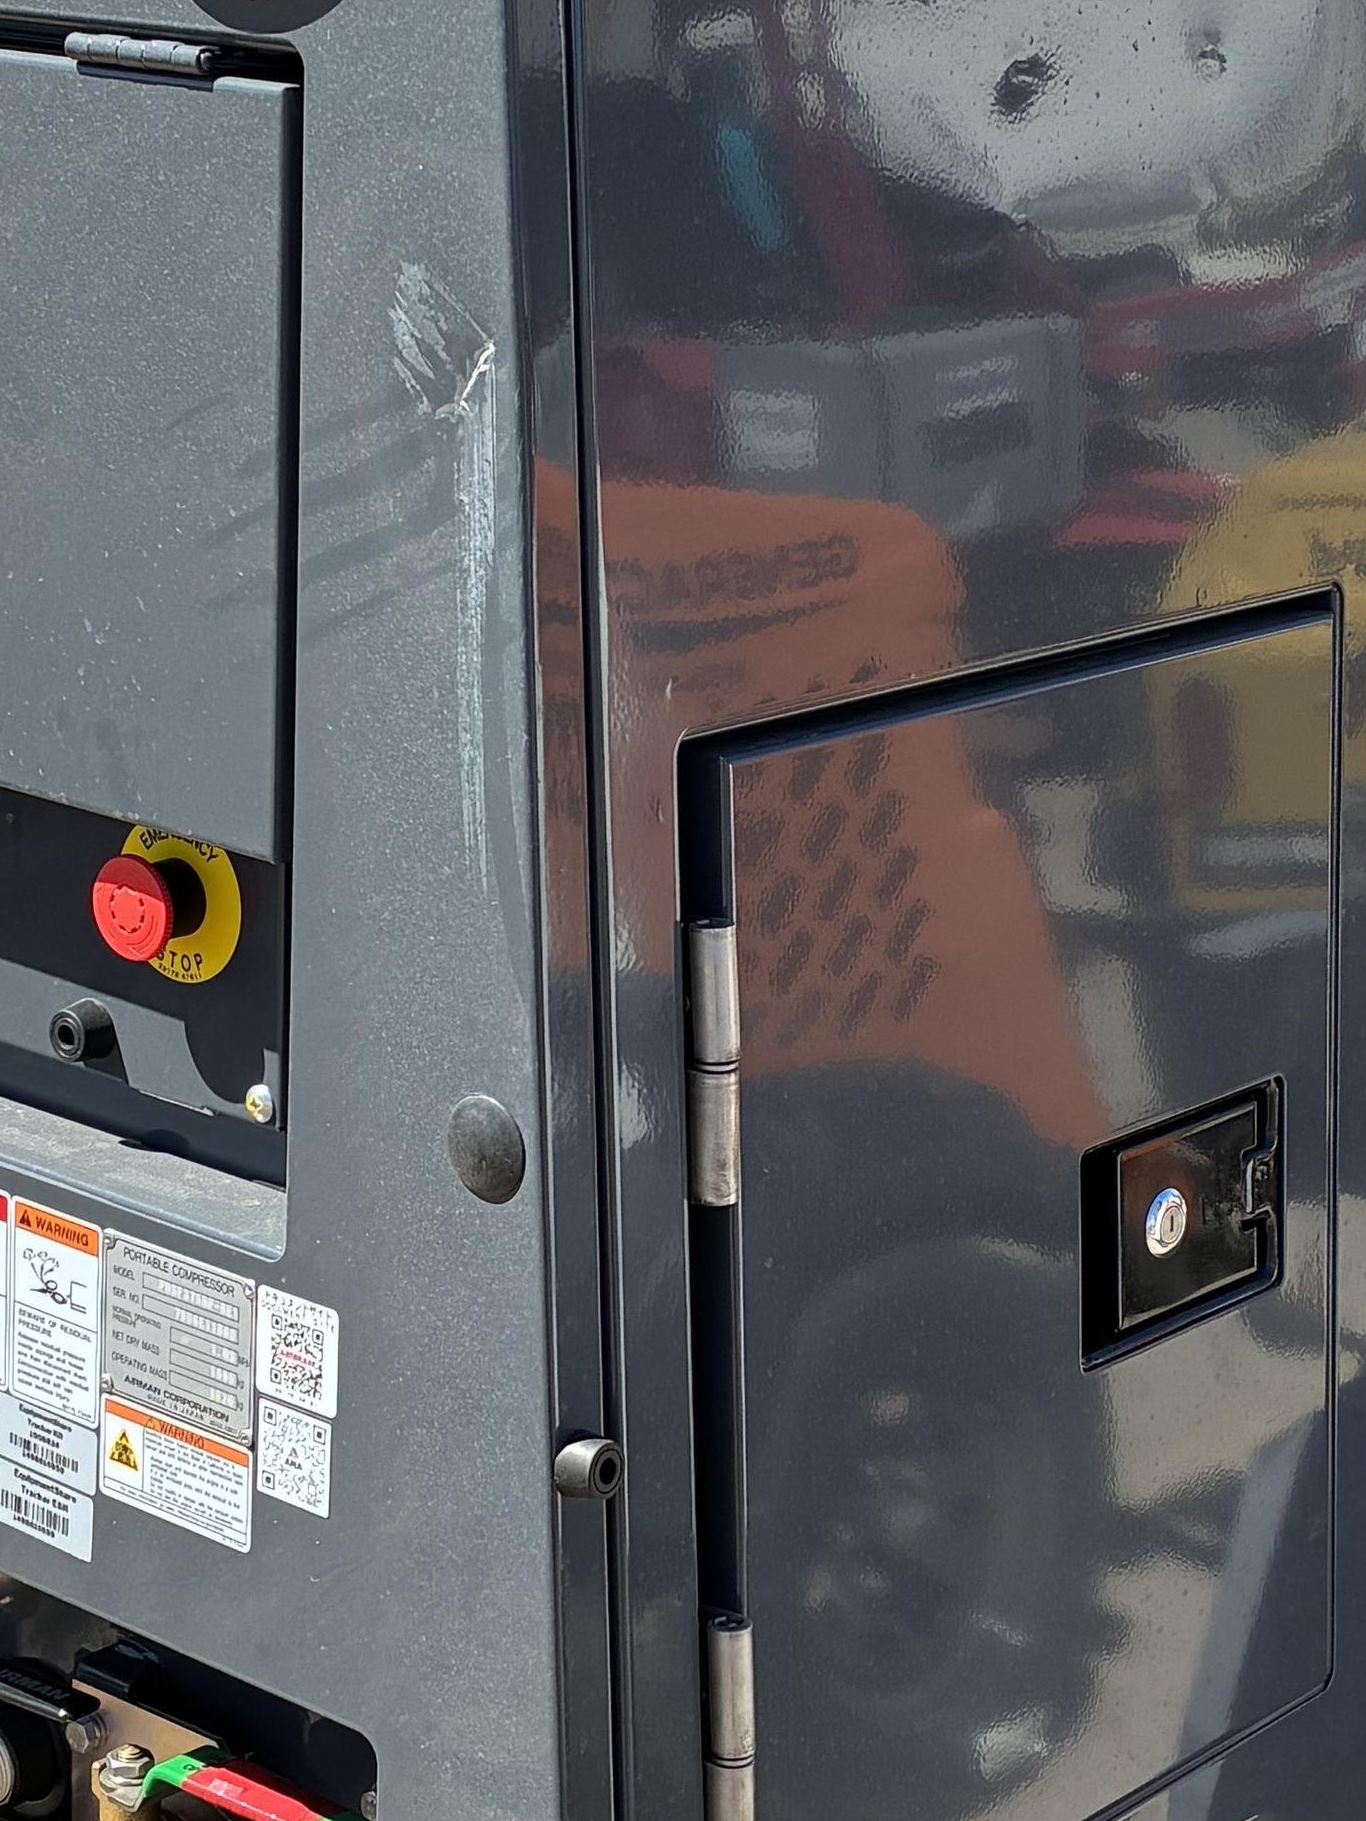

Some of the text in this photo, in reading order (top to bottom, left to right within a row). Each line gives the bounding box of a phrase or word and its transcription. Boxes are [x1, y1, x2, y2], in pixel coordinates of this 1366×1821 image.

[35, 1219, 90, 1248] WARNING
[123, 1246, 235, 1298] PORTABLE COMPRESSOR
[163, 1389, 230, 1423] CORPORATION
